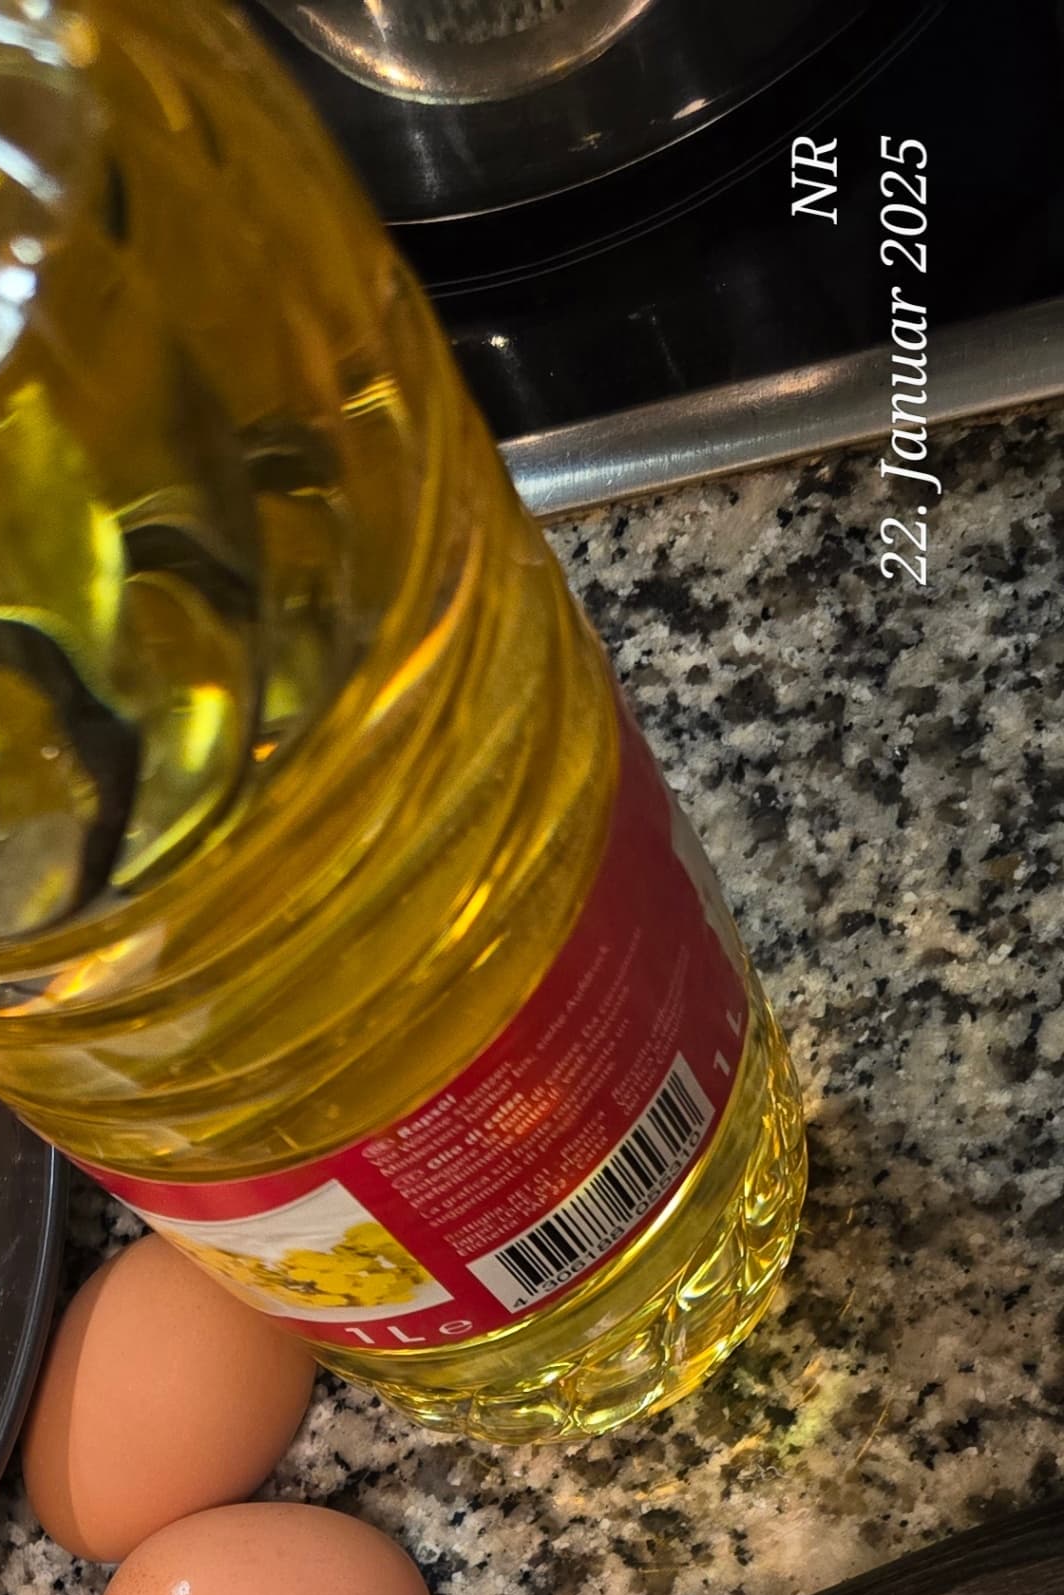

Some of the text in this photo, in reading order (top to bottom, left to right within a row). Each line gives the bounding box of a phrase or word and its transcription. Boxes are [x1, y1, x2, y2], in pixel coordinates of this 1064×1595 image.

[395, 1092, 457, 1140] Rapsöl
[463, 1127, 483, 1145] di
[513, 1099, 551, 1136] entro
[512, 1130, 701, 1309] 4 306188 055310
